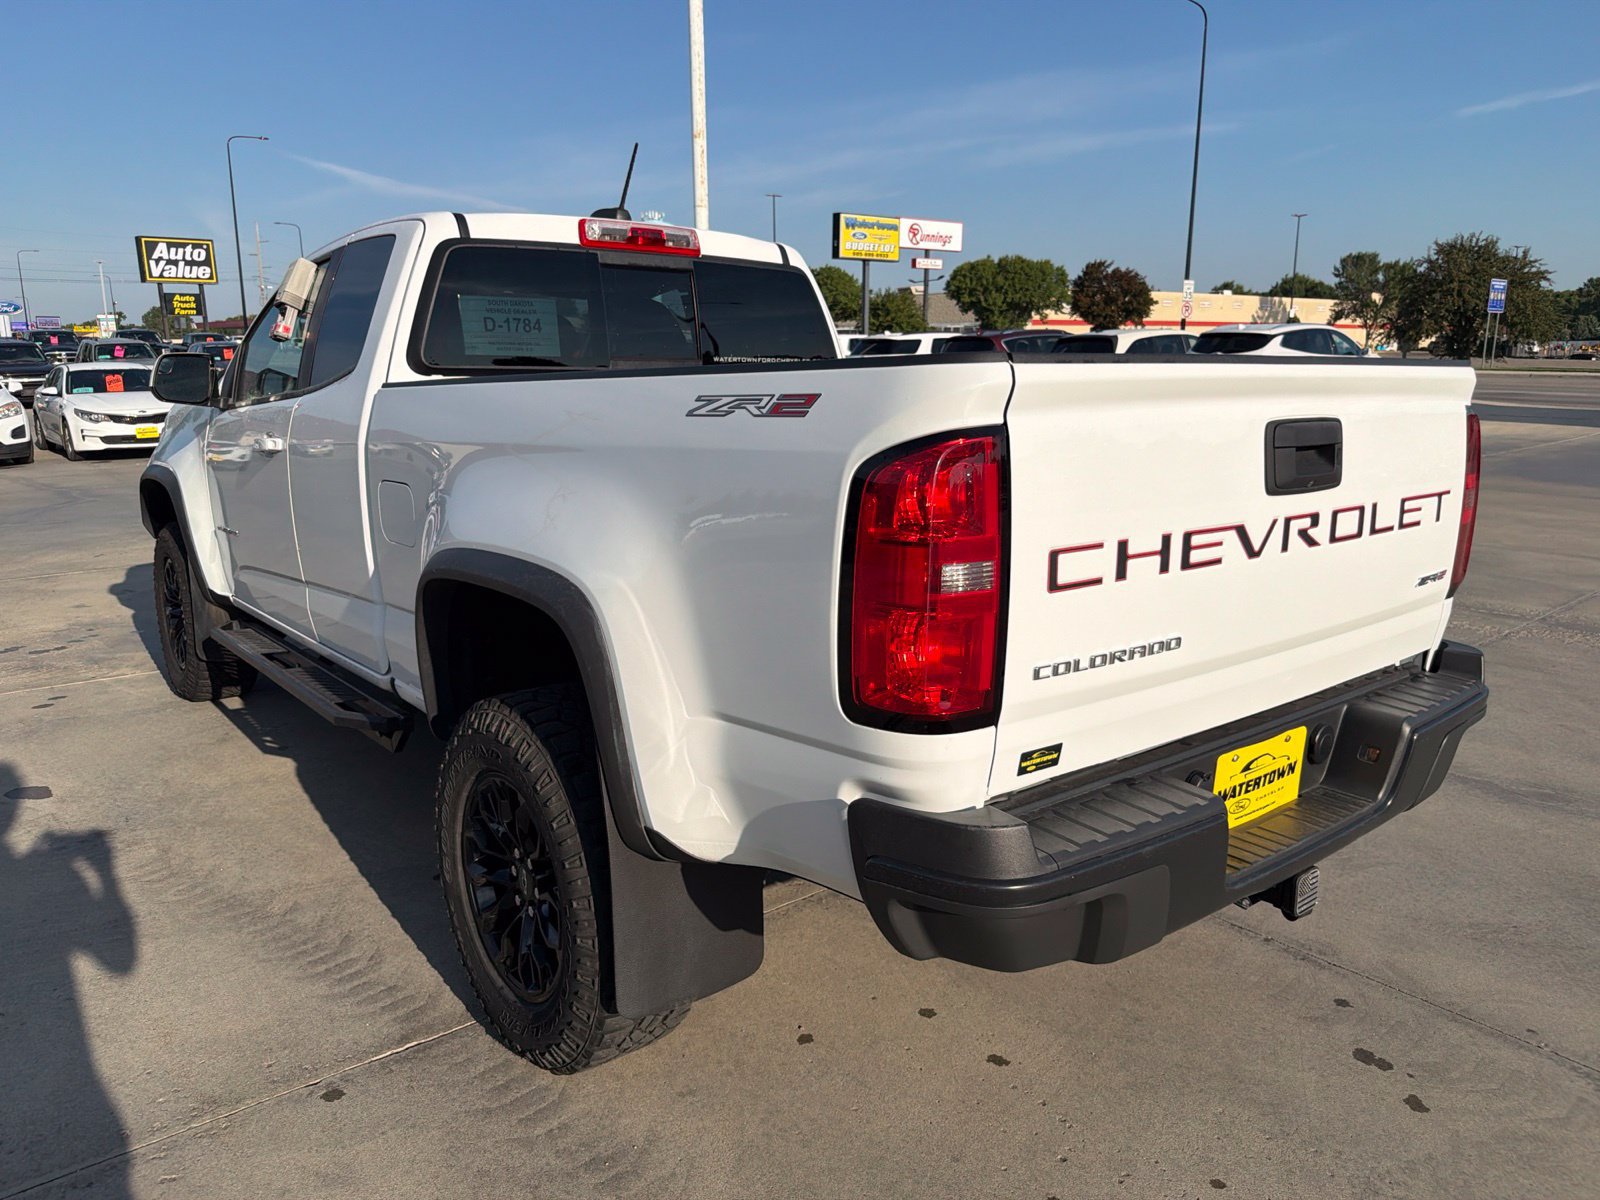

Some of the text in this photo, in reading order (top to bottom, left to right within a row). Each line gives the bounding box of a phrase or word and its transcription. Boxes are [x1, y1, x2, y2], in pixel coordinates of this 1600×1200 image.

[908, 223, 953, 247] Runnings
[152, 242, 206, 261] Auto
[845, 241, 896, 253] BUDGET LOT
[149, 260, 212, 279] Value
[172, 301, 197, 309] Truck
[173, 294, 196, 302] Auto
[483, 316, 543, 333] D-1784
[686, 393, 822, 418] ZR2
[1047, 490, 1450, 593] CHEVROLET
[1033, 636, 1182, 680] COLORADO
[1218, 761, 1297, 801] WATERTOWN
